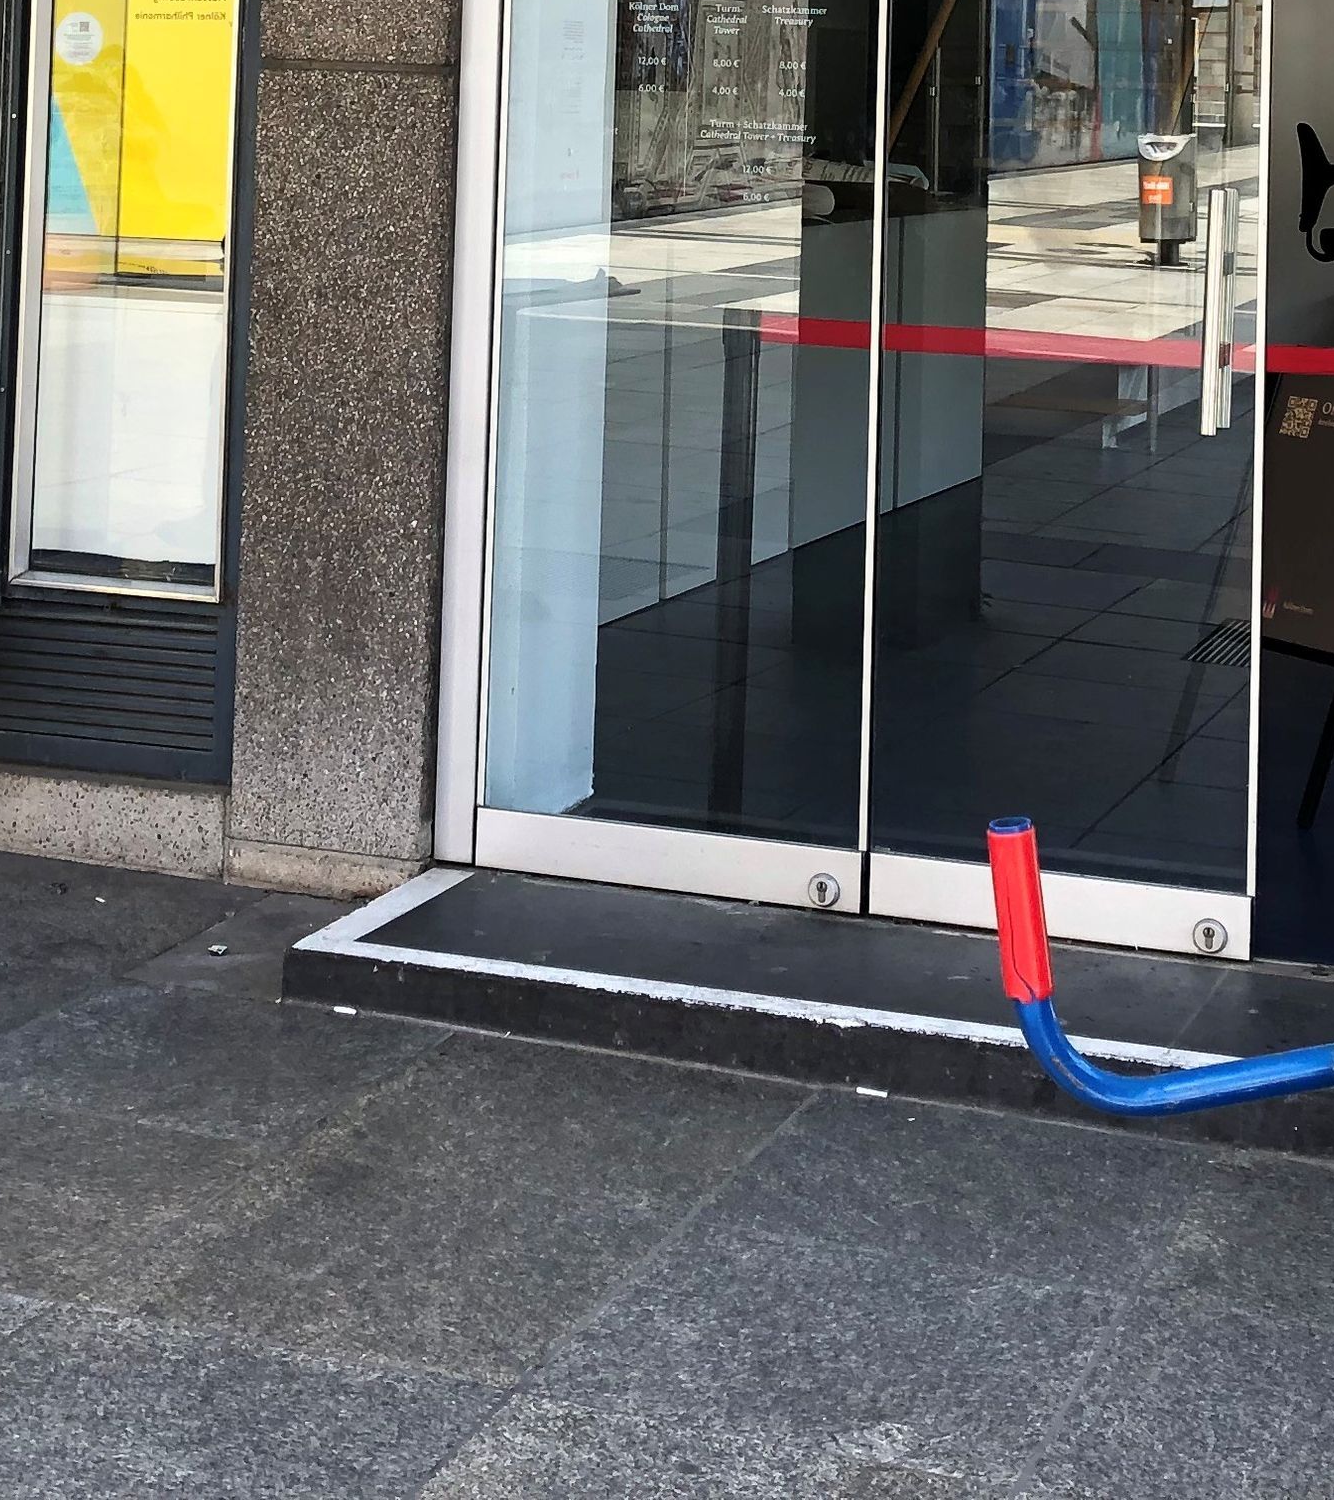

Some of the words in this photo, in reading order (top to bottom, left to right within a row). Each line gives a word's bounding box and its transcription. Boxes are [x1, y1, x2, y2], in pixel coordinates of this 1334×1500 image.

[659, 2, 679, 12] Dom
[761, 4, 827, 15] Schatzkammer
[637, 12, 669, 23] Cologne
[707, 14, 747, 24] Cathedral
[774, 16, 814, 28] Treasury
[632, 23, 673, 33] Cathedral
[713, 25, 740, 35] Tower
[709, 119, 734, 128] Turm
[742, 120, 808, 131] Schatzkammer
[700, 129, 741, 140] Cathedral
[743, 131, 769, 140] Tower
